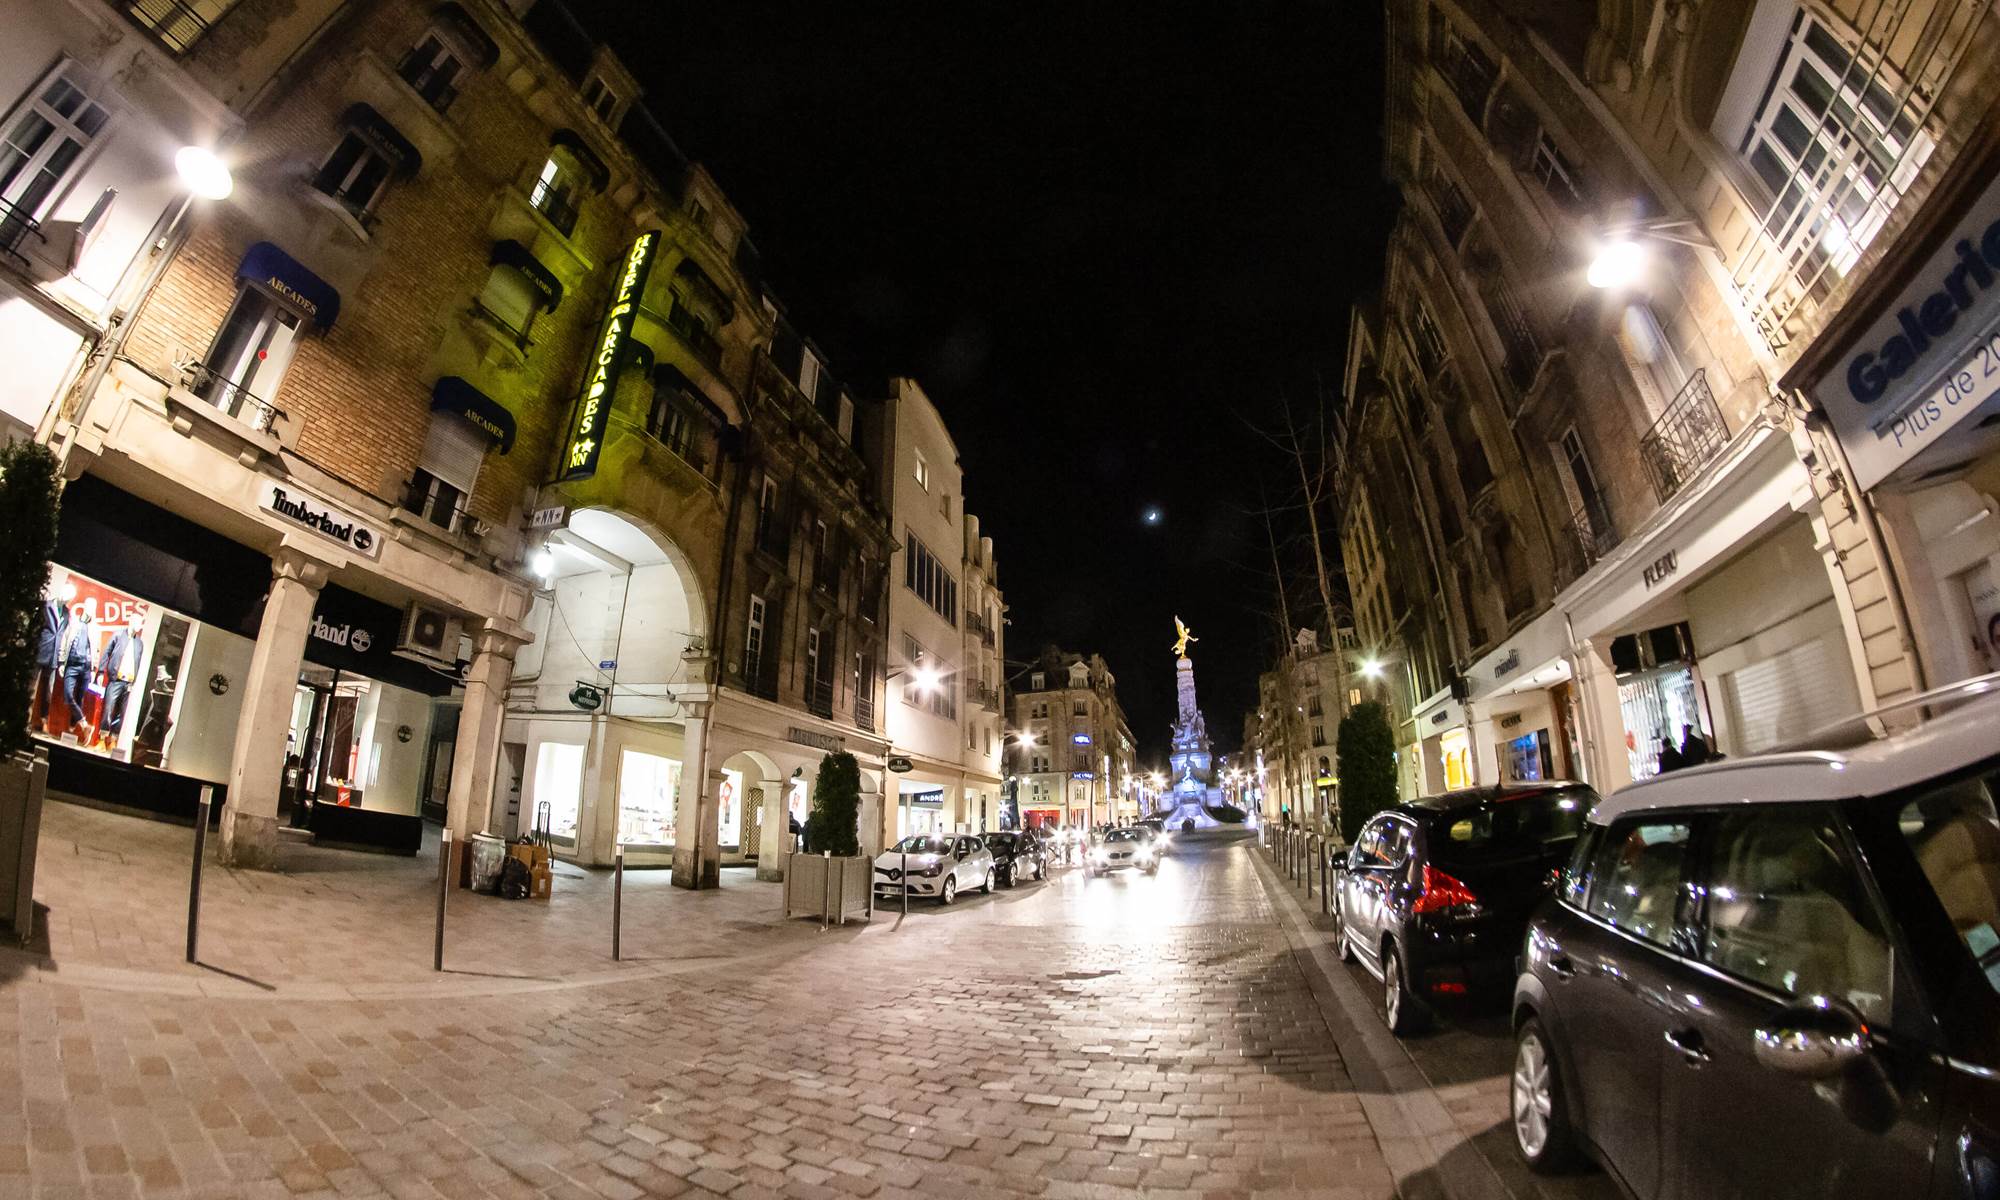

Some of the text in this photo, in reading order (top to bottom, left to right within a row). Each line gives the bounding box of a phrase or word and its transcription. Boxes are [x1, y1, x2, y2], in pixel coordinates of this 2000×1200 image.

[265, 276, 319, 316] ARCADES
[617, 234, 652, 303] HOTEL
[580, 318, 621, 434] ARCADES
[464, 408, 505, 439] ARCADES
[1891, 400, 1942, 448] Plus
[1943, 370, 1975, 406] de
[272, 487, 353, 542] Timberland
